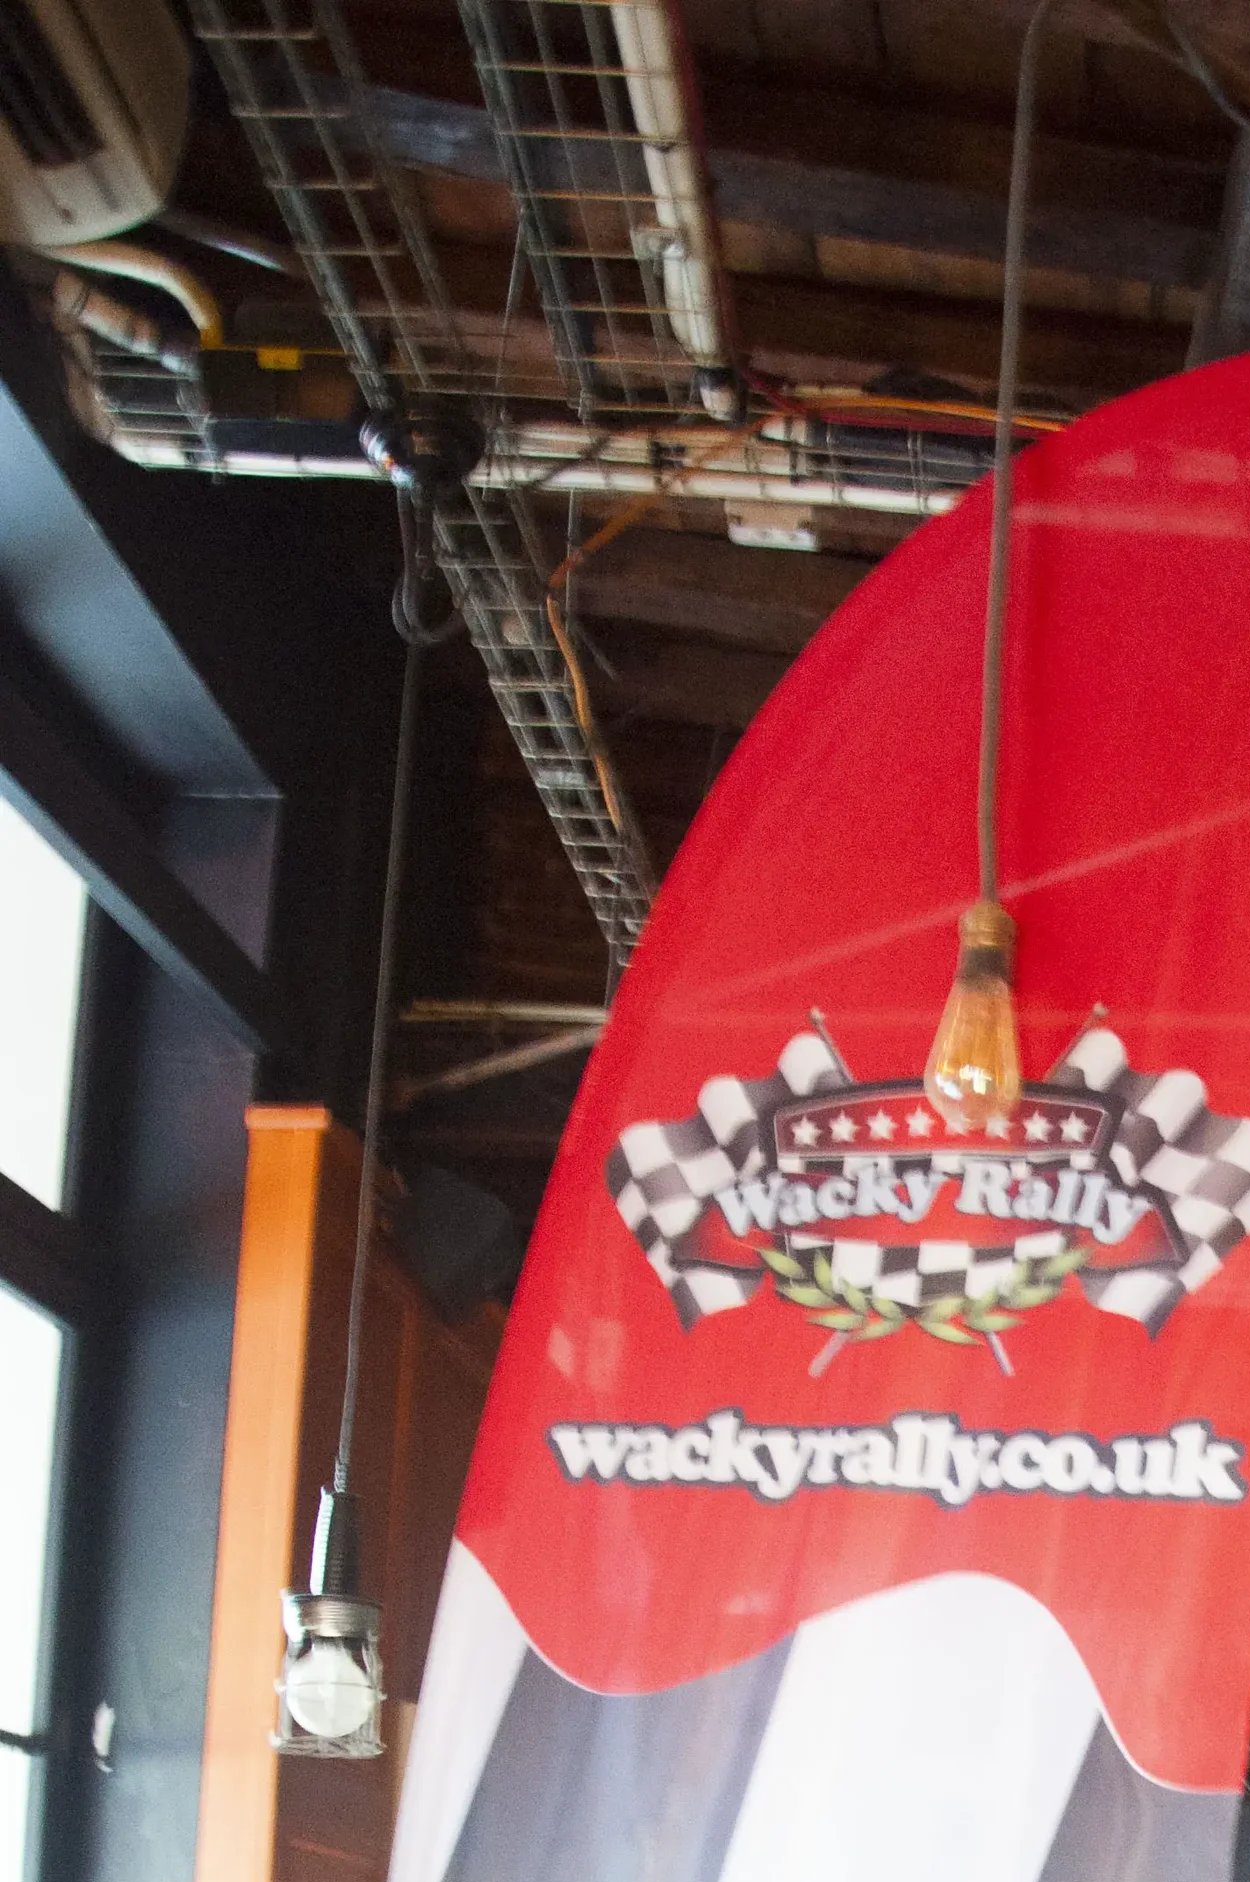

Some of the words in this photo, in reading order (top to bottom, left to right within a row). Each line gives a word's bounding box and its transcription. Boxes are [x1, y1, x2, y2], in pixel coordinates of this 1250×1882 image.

[713, 1157, 939, 1236] Wacky
[955, 1160, 1150, 1244] Rally
[550, 1409, 1246, 1506] wackyrally.co.uk
